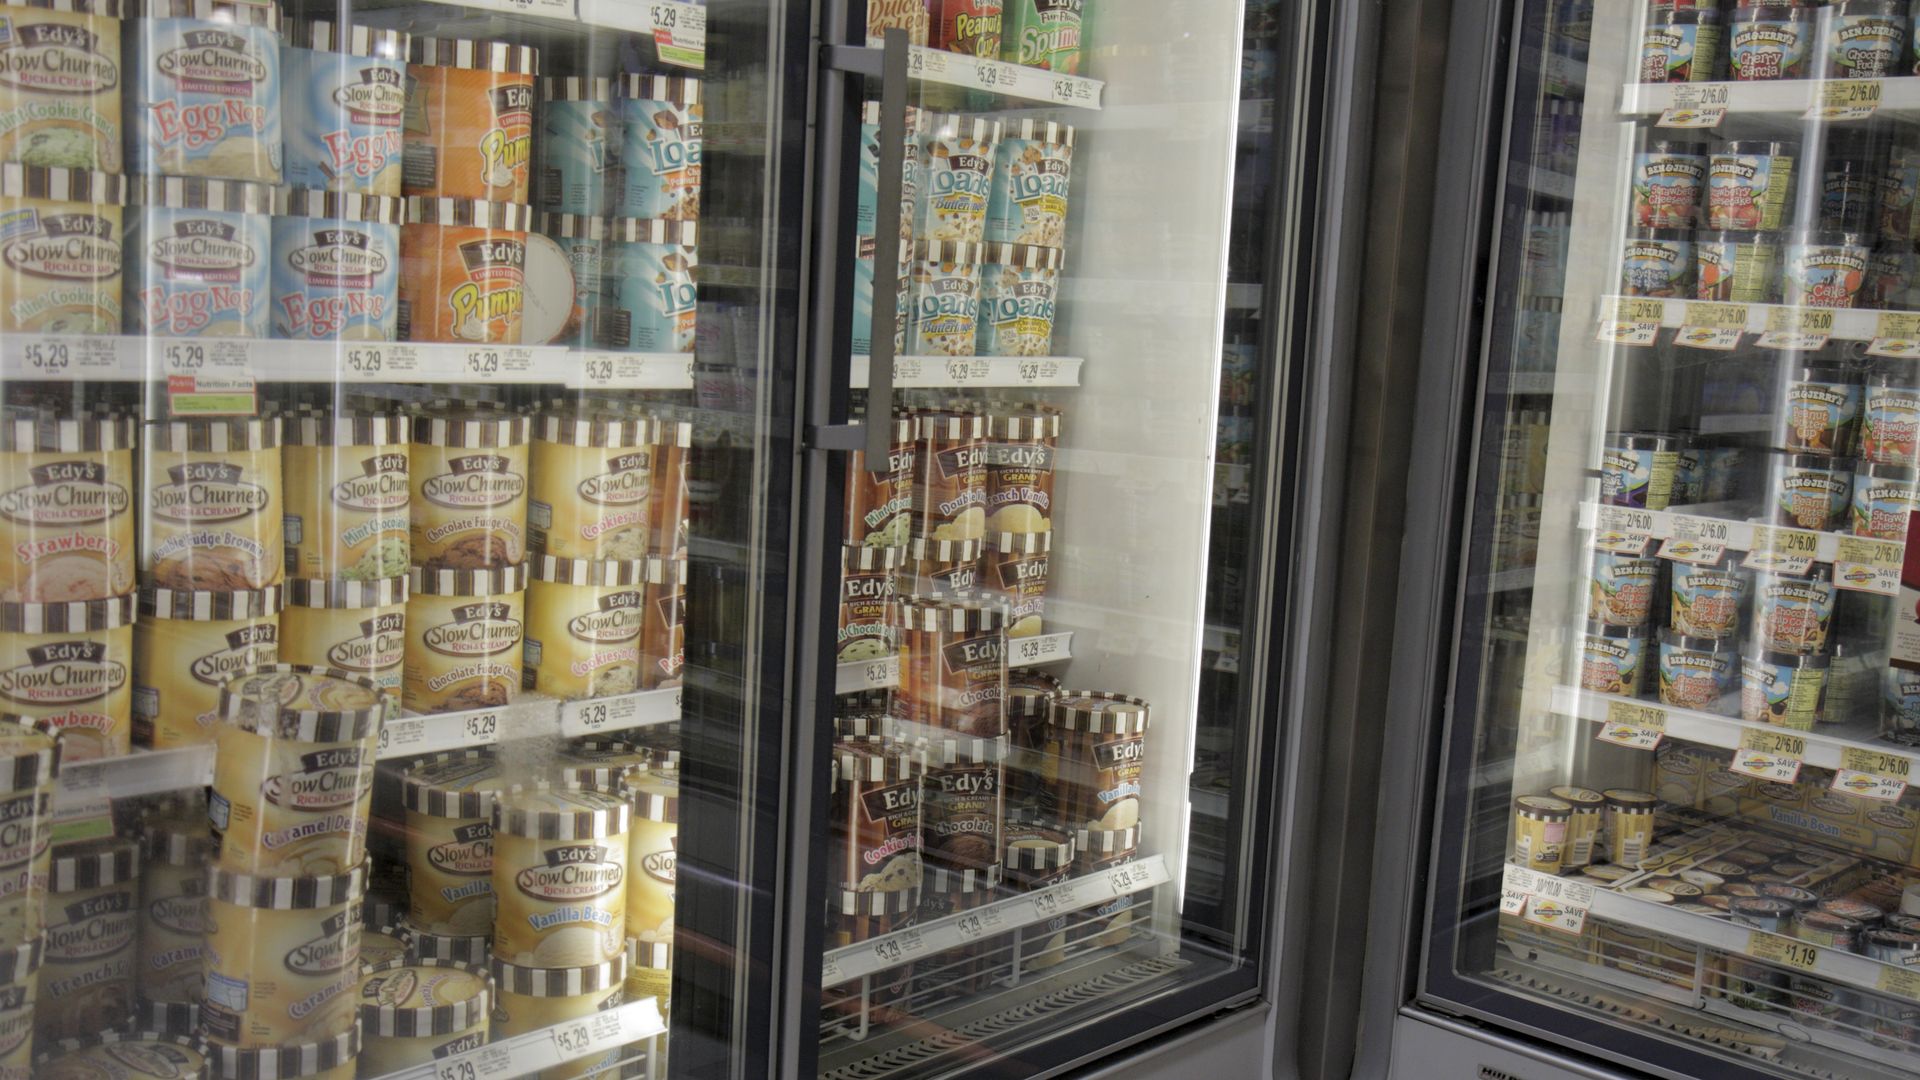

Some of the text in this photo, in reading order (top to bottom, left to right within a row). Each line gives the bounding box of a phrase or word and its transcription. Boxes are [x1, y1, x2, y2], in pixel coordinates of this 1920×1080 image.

[650, 6, 676, 28] $5.29
[35, 27, 86, 47] Edy's
[196, 34, 236, 51] Edy's
[1018, 27, 1081, 63] Spum
[1741, 52, 1781, 67] Cherry
[977, 66, 997, 85] $5.29
[153, 100, 267, 147] Egg Nog
[323, 131, 384, 175] Egg
[959, 157, 987, 171] Edy's
[64, 219, 105, 239] Edy's
[186, 223, 225, 239] Edy's
[325, 233, 361, 250] Edy's
[943, 280, 970, 293] Edy's
[1022, 284, 1047, 296] Edy's
[1813, 284, 1845, 298] Cake
[282, 291, 344, 337] Egg
[346, 291, 385, 320] Nog
[1637, 322, 1656, 332] SAVE
[25, 344, 68, 370] $5.29
[167, 347, 203, 371] $5.29
[349, 349, 381, 373] $5.29
[468, 352, 498, 375] $5.29
[586, 358, 613, 381] $5.29
[463, 456, 501, 473] Edy's
[618, 456, 646, 471] Edy's
[997, 446, 1046, 466] Edy's
[47, 464, 97, 481] Edy's
[184, 466, 228, 480] Edy's
[1003, 473, 1037, 485] GRAND
[432, 477, 465, 499] Slow
[940, 490, 975, 515] Double
[1021, 488, 1049, 509] Vanilla
[864, 509, 888, 530] Mint
[429, 520, 474, 542] Chocolate
[17, 532, 119, 562] Strawberry
[1877, 570, 1900, 579] SAVE
[848, 578, 894, 597] Edy's
[608, 594, 638, 610] Edy's
[465, 606, 502, 622] Edy's
[240, 628, 272, 645] Edy's
[576, 614, 609, 639] Slow
[430, 624, 521, 650] Slow Churned
[43, 644, 96, 661] Edy's
[335, 643, 374, 663] Slow
[1020, 642, 1039, 657] $5.29
[199, 653, 245, 680] Slow
[866, 663, 887, 680] $5.29
[1, 663, 122, 692] Slow Churned
[430, 667, 475, 689] Chocolate
[580, 705, 606, 724] $5.29
[467, 716, 497, 737] $5.29
[318, 751, 358, 768] Edy's
[1775, 757, 1797, 768] SAVE
[942, 775, 993, 795] Edy's
[1879, 777, 1904, 789] SAVE
[937, 820, 993, 836] Chocolate
[1770, 806, 1839, 837] Vanilla Bean
[263, 820, 332, 850] Caramel
[434, 848, 471, 867] Slow
[558, 849, 597, 863] Edy's
[521, 862, 621, 889] Slow Churned
[443, 882, 491, 903] Vanilla
[1506, 890, 1524, 901] SAVE
[529, 905, 612, 931] Vanilla Bean
[1564, 906, 1584, 917] SAVE
[1785, 945, 1816, 966] $1.19
[558, 1029, 590, 1052] $5.29
